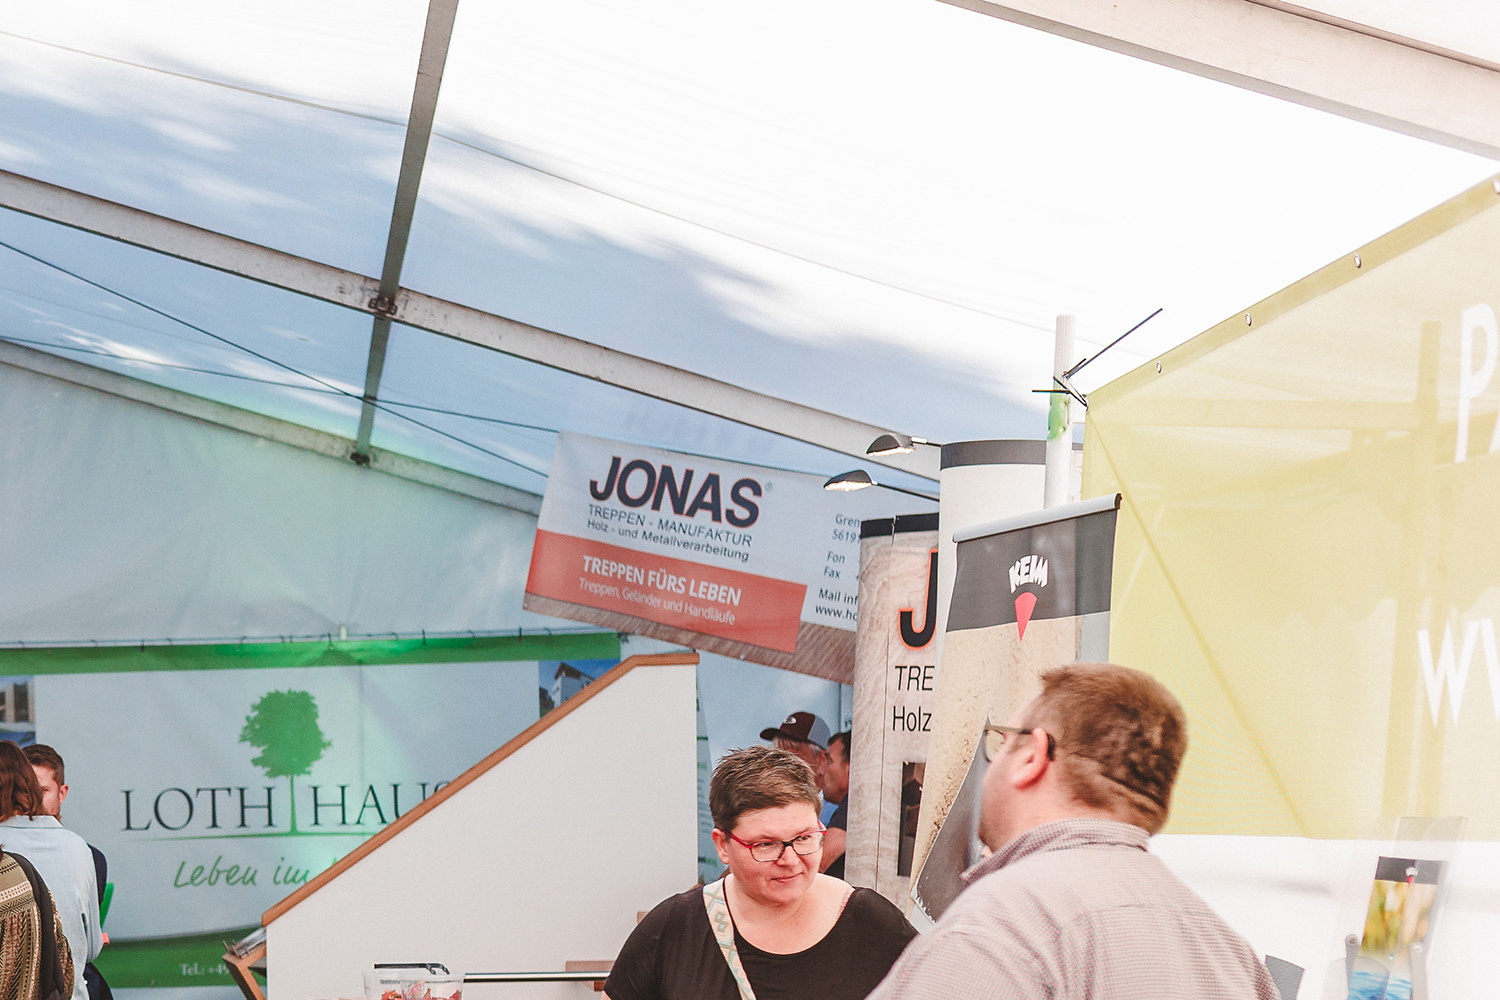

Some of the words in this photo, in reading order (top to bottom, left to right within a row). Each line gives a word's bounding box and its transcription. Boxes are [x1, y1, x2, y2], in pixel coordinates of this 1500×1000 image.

[1455, 303, 1500, 464] P
[589, 456, 763, 529] JONAS
[587, 519, 609, 534] Holz
[618, 525, 639, 539] und
[642, 529, 749, 563] Metallverarbeitung
[588, 503, 646, 527] TREPPEN
[657, 518, 753, 548] MANUFAKTUR
[823, 565, 841, 579] Fax
[827, 549, 846, 565] Fon
[1008, 554, 1049, 594] KEIM
[579, 576, 621, 600] Treppen,
[663, 599, 683, 615] und
[684, 602, 736, 626] Handläufe
[583, 554, 645, 586] TREPPEN
[647, 568, 687, 595] FÜRS
[689, 578, 742, 607] LEBEN
[818, 587, 841, 603] Mail
[894, 665, 936, 692] TRE
[892, 704, 933, 732] Holz
[120, 784, 277, 833] LOTH
[308, 780, 451, 828] HAU
[173, 855, 259, 889] Leben
